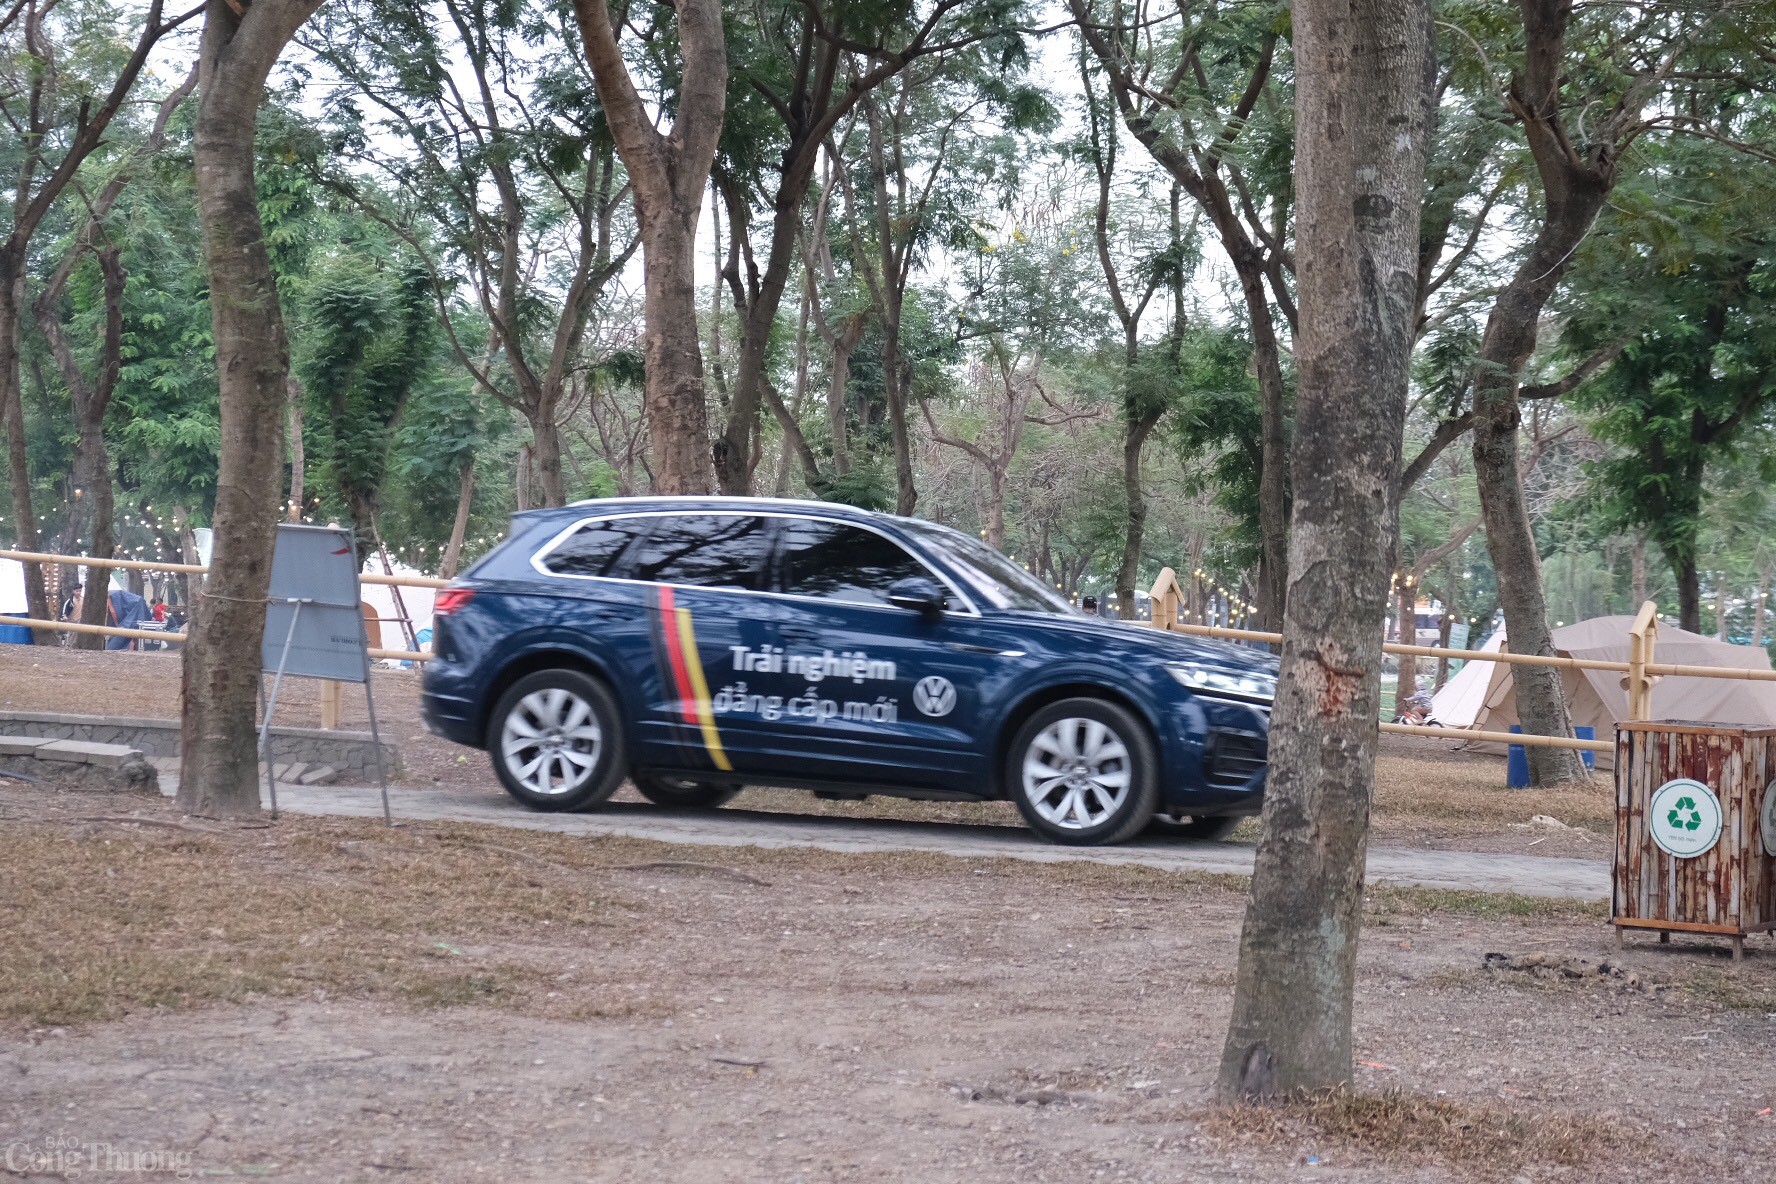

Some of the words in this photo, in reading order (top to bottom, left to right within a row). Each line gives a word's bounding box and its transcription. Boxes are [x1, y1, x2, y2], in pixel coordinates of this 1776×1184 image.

[729, 644, 783, 673] Trải
[787, 650, 896, 684] nghiệm
[787, 687, 838, 724] cấp
[842, 696, 898, 723] mới
